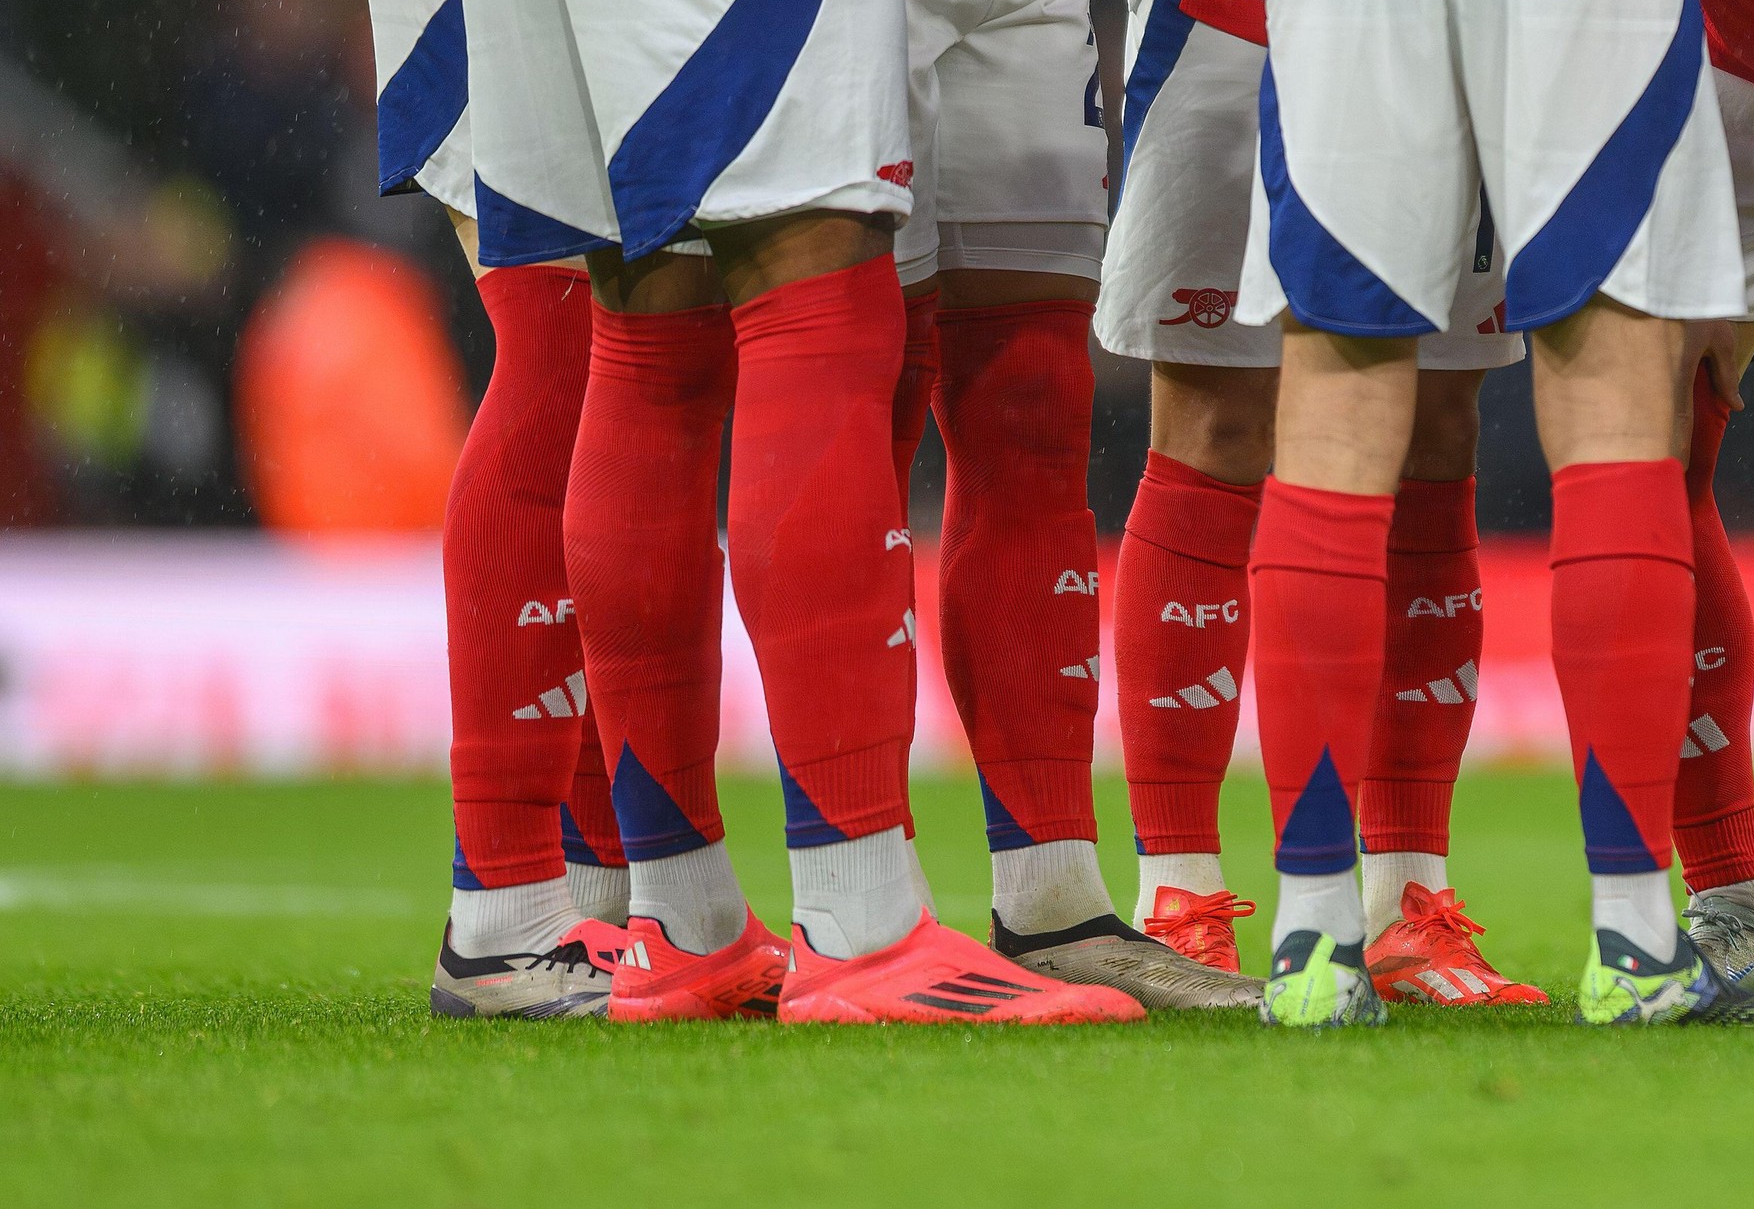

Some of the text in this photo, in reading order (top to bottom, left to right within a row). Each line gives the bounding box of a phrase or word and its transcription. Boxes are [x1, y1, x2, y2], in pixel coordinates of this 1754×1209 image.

[518, 599, 576, 627] AF
[1161, 599, 1239, 628] AFC
[1407, 587, 1482, 618] AFC
